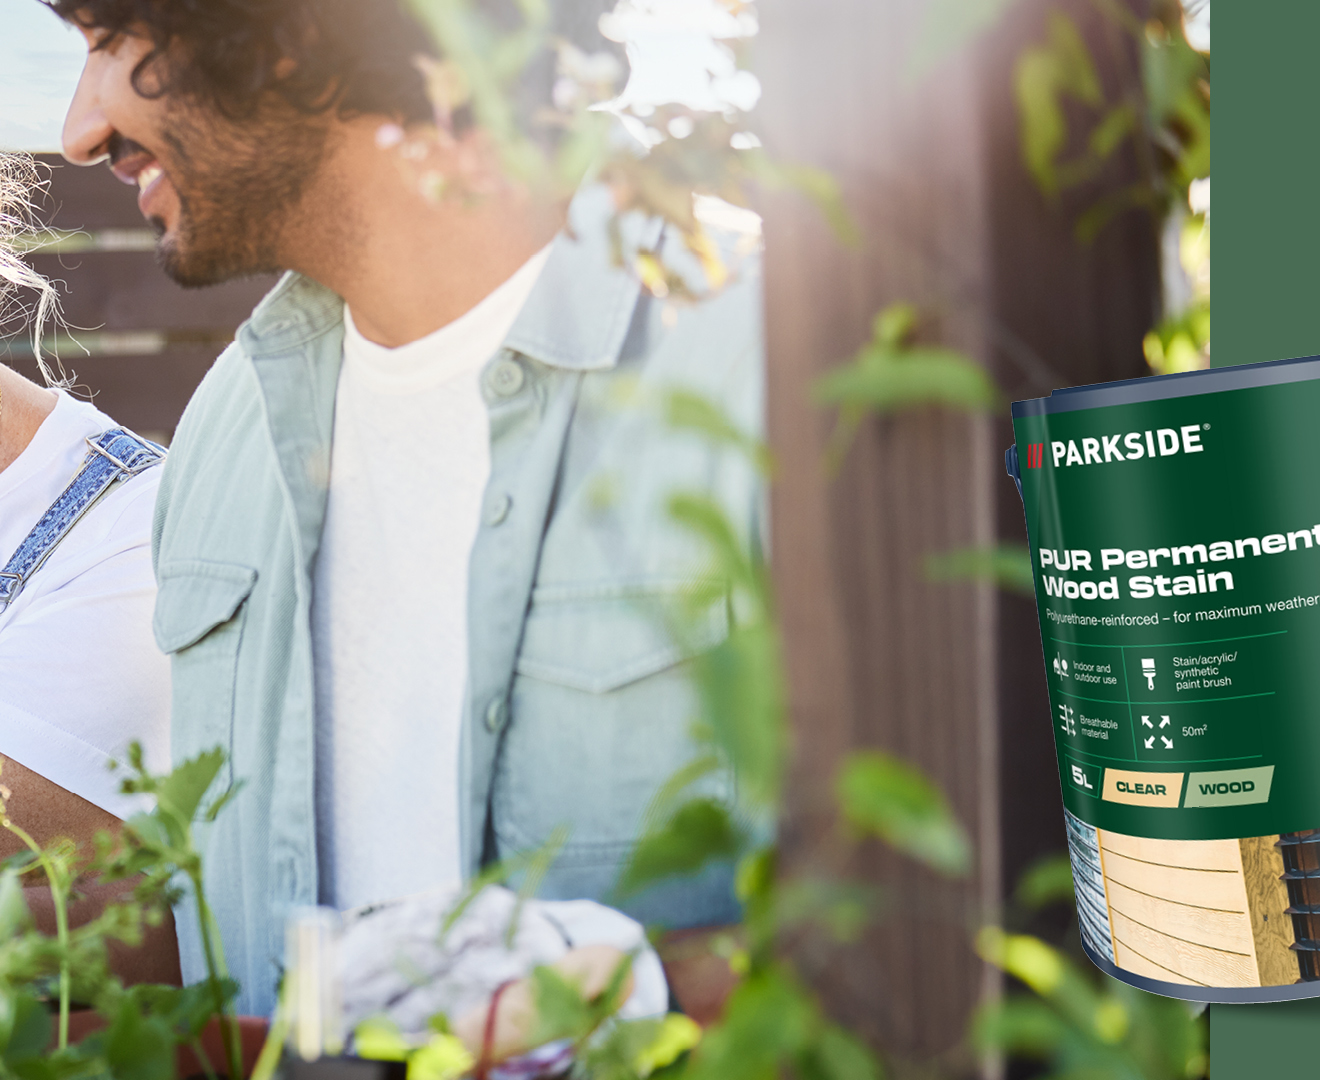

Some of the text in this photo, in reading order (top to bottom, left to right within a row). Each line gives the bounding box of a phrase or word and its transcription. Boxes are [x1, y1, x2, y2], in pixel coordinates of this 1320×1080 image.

[1039, 547, 1093, 572] PUR
[1042, 568, 1235, 600] Wood Stain
[1046, 607, 1160, 627] Polyurethane-reinforced
[1173, 610, 1192, 624] for
[1195, 603, 1262, 622] maximum
[1072, 660, 1111, 673] Indoor and
[1172, 651, 1238, 667] Stain/acrylic/
[1074, 672, 1117, 685] outdoor use
[1174, 665, 1220, 679] synthetic
[1175, 676, 1232, 692] paint brush
[1079, 714, 1119, 730] Breathable
[1081, 728, 1109, 740] material
[1071, 763, 1094, 790] 5L
[1116, 780, 1167, 796] CLEAR
[1198, 780, 1256, 796] WOOD
